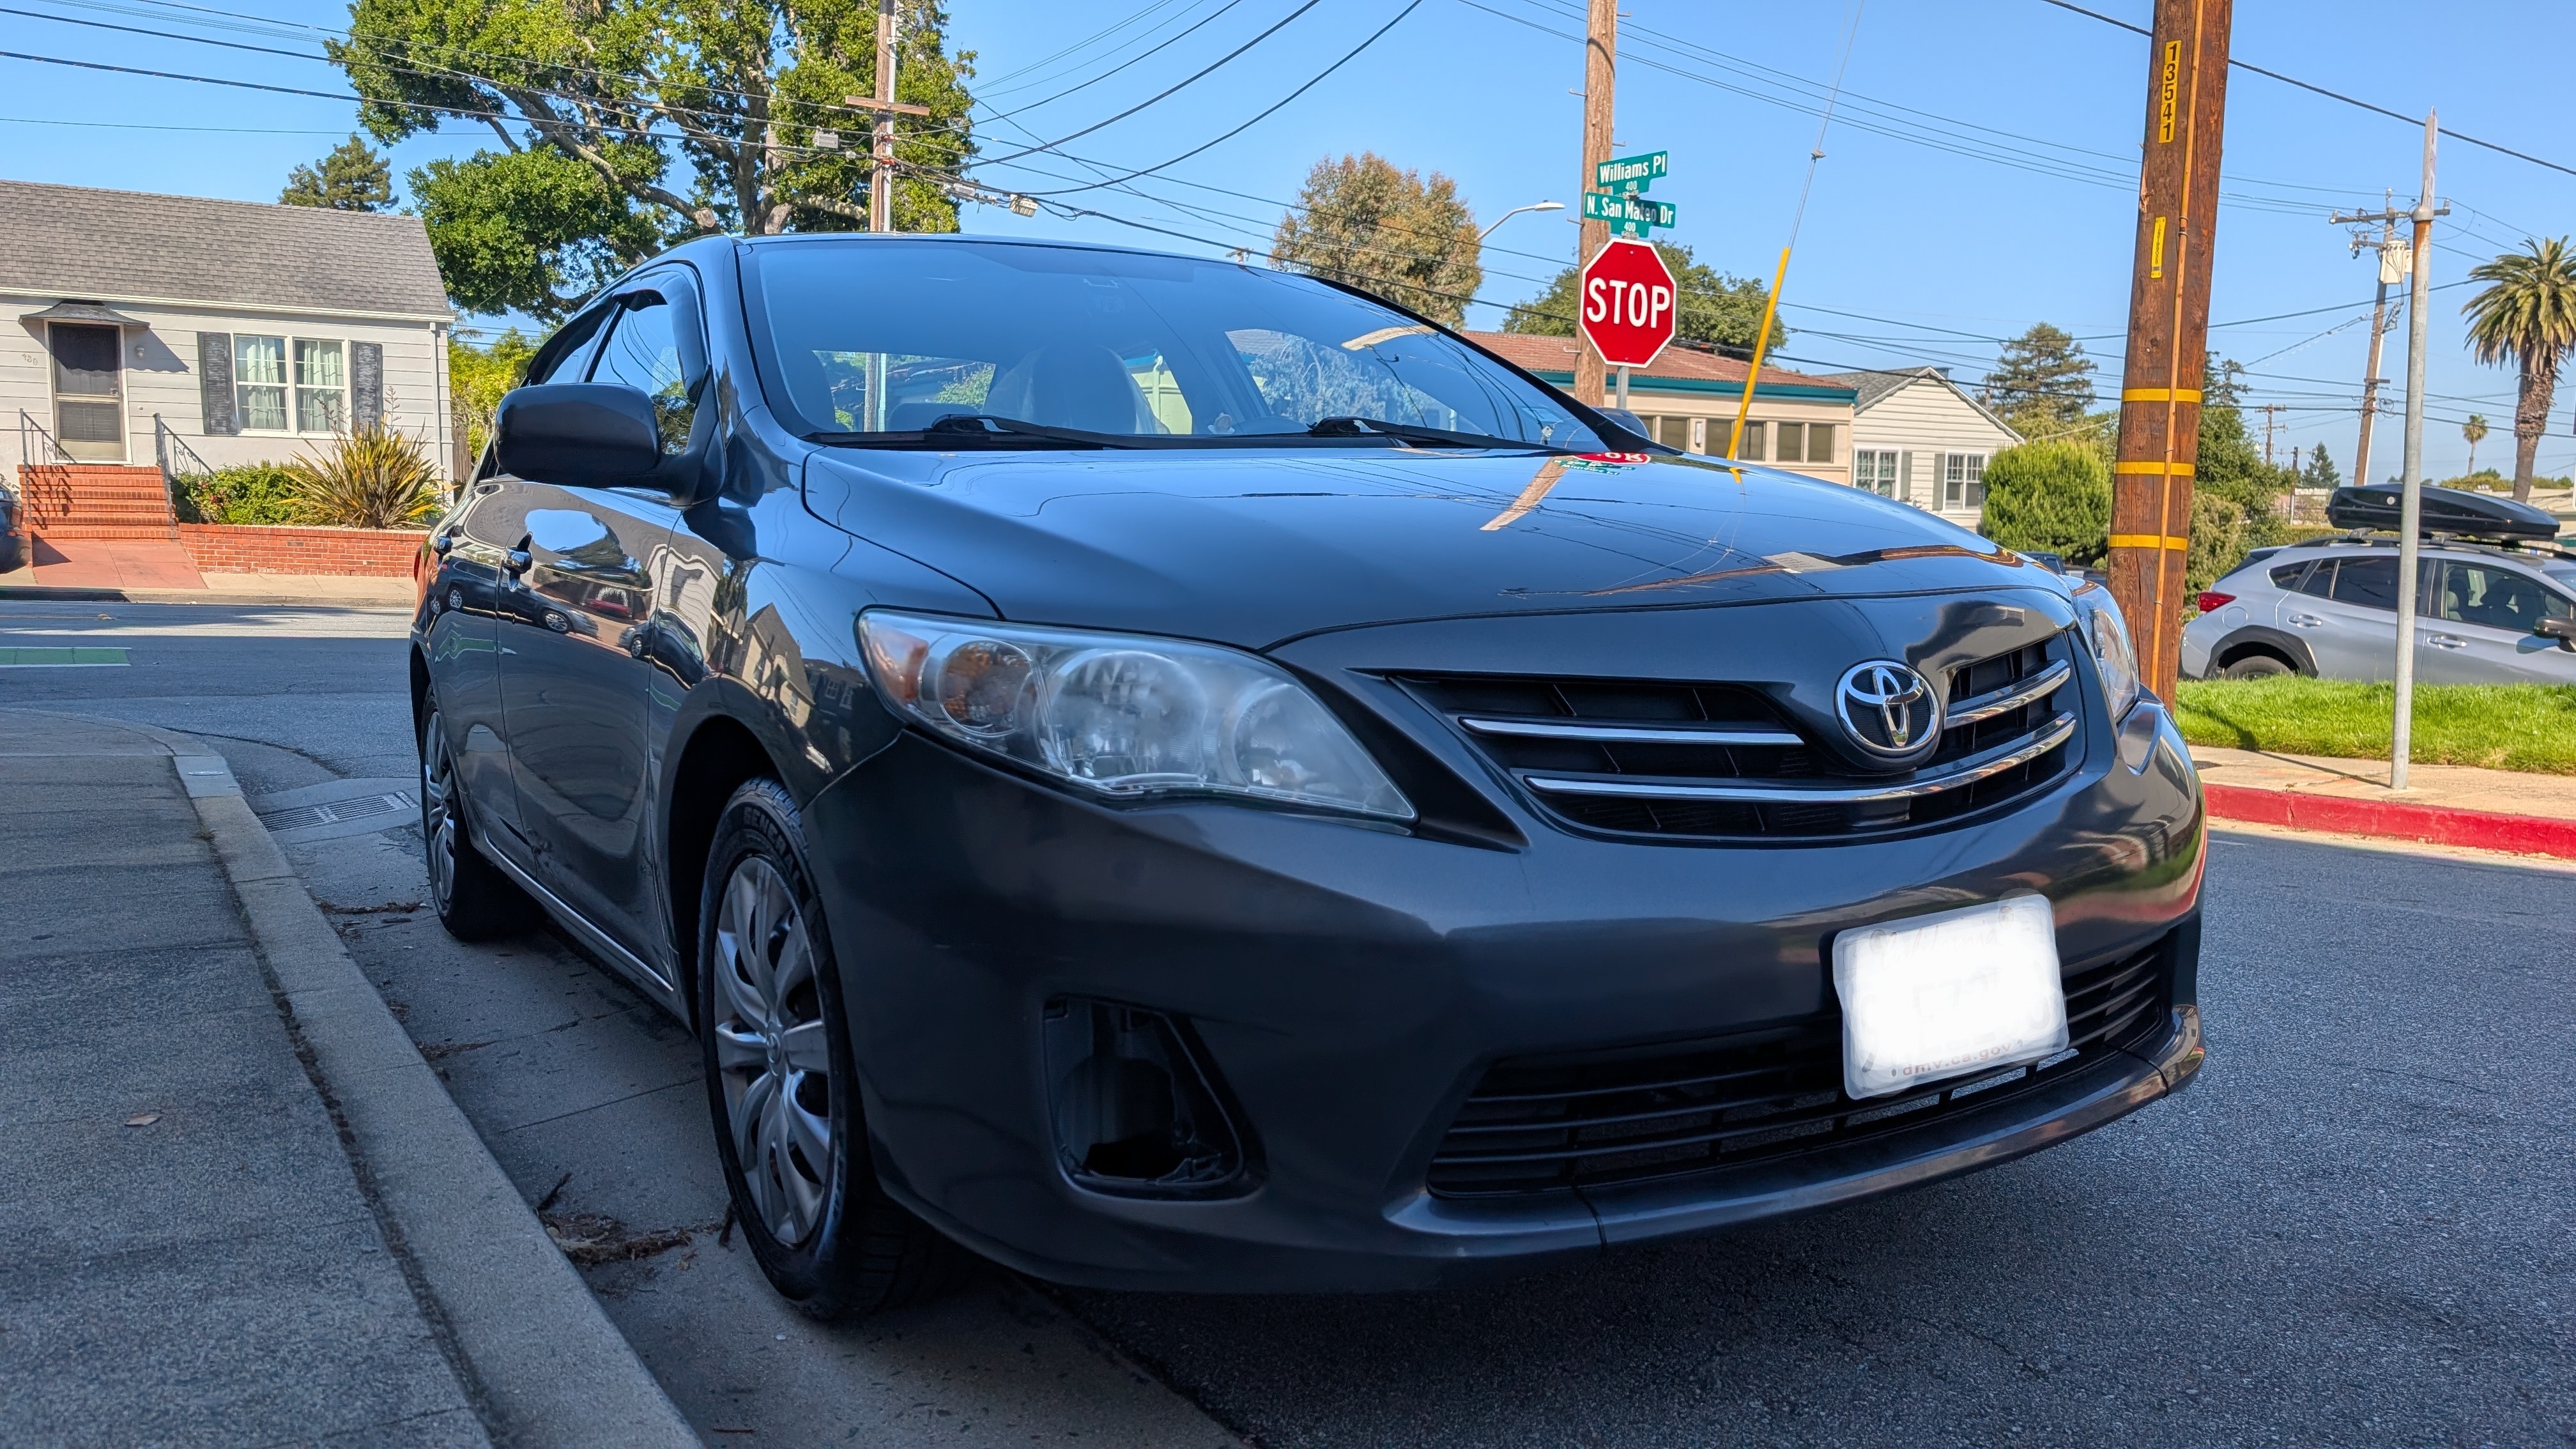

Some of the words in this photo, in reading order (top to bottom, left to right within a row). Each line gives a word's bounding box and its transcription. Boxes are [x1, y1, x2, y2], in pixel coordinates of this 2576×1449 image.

[2163, 43, 2177, 140] 13541
[1600, 162, 1649, 183] Williams
[1653, 154, 1666, 174] Pl
[1625, 180, 1637, 190] 400
[1586, 195, 1598, 215] N.
[1601, 197, 1622, 218] San
[1625, 200, 1657, 222] Mateo
[1660, 205, 1674, 224] Dr
[1624, 222, 1636, 232] 400
[1586, 277, 1671, 328] STOP
[22, 353, 38, 365] 430
[1902, 1043, 2012, 1076] dmv.ca.gov
